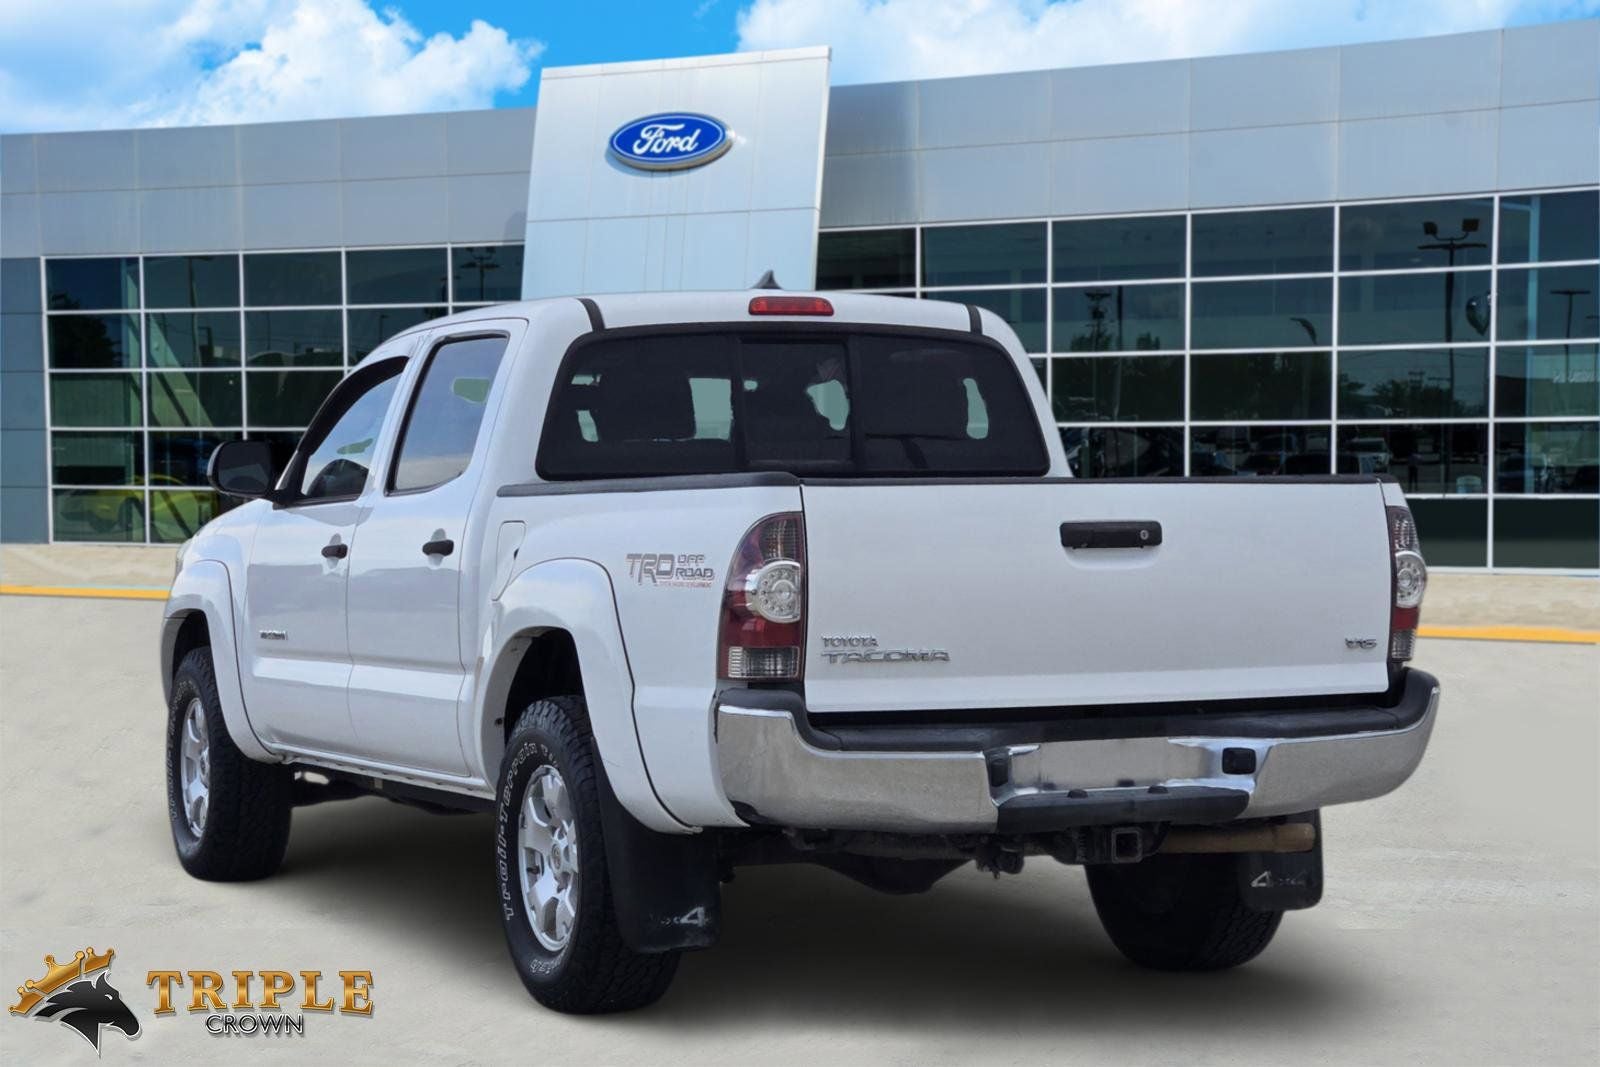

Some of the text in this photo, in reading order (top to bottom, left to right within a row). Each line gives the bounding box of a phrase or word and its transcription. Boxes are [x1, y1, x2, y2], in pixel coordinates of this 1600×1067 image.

[632, 123, 702, 155] Ford
[677, 553, 706, 565] OFF
[626, 553, 676, 585] TRD
[675, 567, 715, 579] ROAD
[822, 635, 879, 648] TOYOTA
[821, 650, 951, 664] TACOMA
